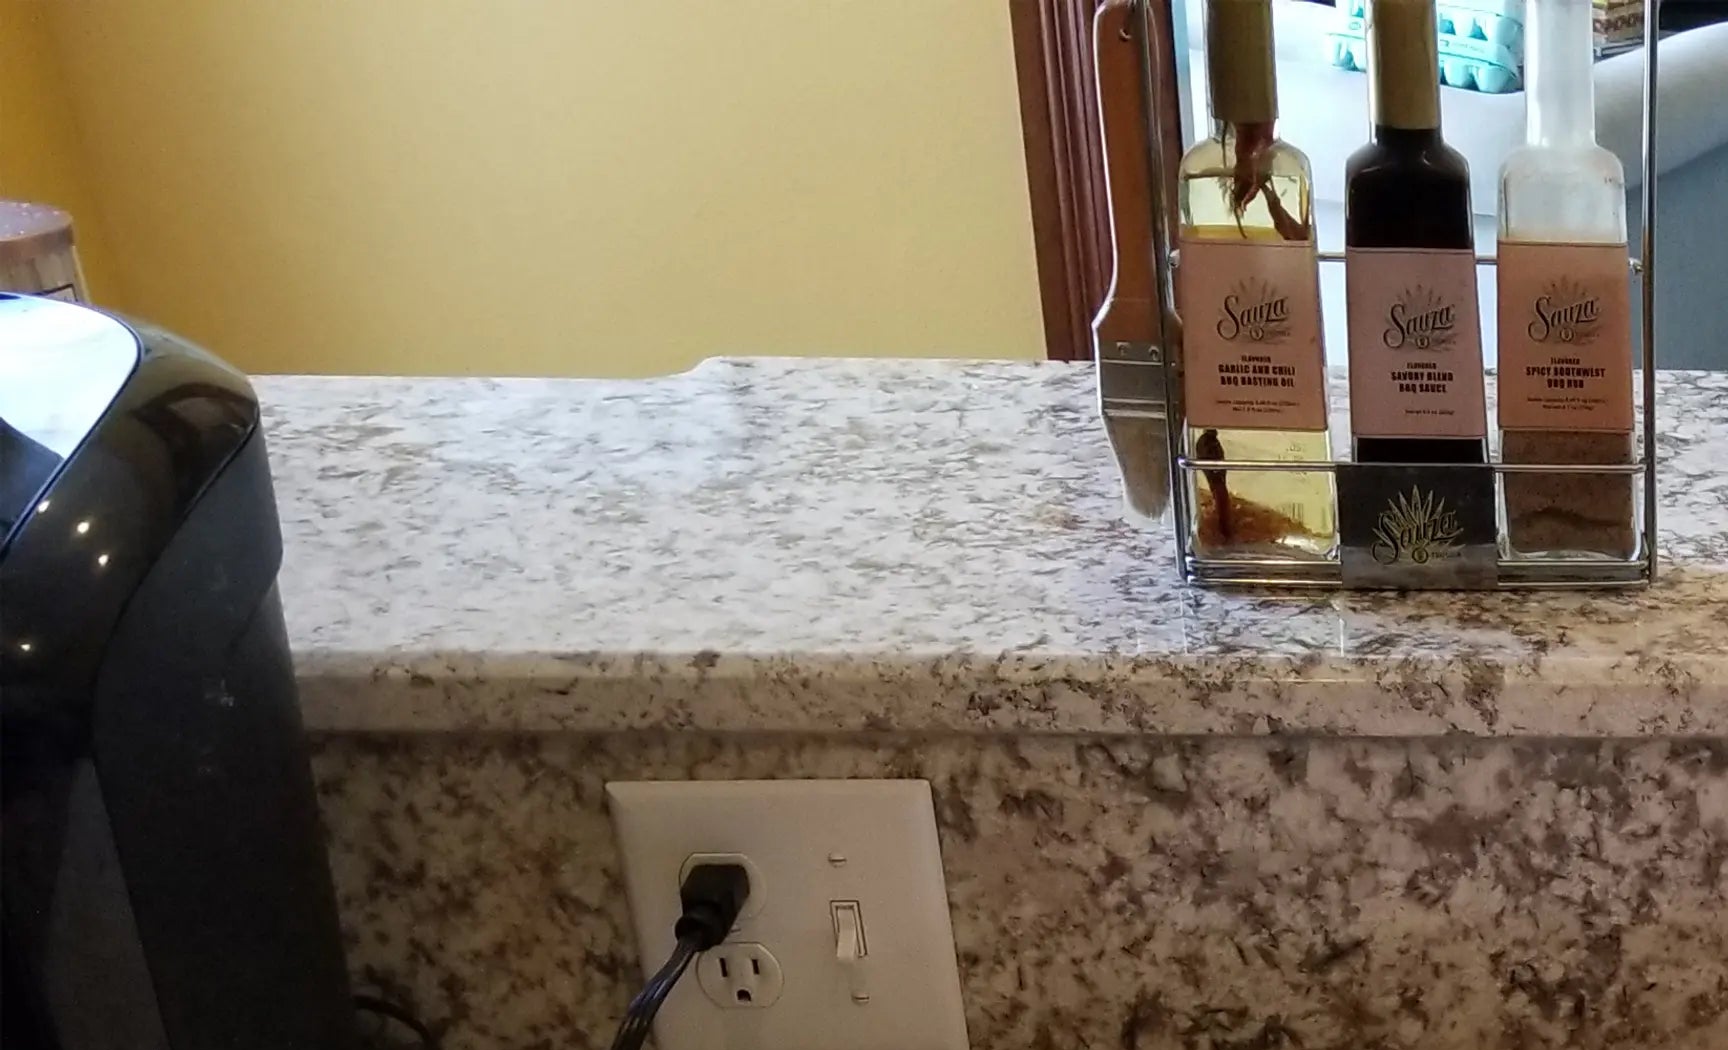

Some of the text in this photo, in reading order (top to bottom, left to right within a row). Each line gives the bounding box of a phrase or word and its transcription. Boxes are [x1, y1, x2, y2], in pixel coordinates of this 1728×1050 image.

[1217, 294, 1289, 340] Sauza
[1528, 296, 1599, 342] Sauza
[1383, 303, 1455, 349] Sauza
[1218, 364, 1296, 376] GARLIC AND CHILI
[1391, 371, 1453, 381] SAVORY BLEND
[1526, 366, 1606, 377] SPICY SOUTHWEST
[1221, 376, 1295, 388] BBQ BASTING OIL
[1399, 383, 1447, 393] BBQ SAUCE
[1547, 378, 1584, 389] BBQ RUB
[1371, 510, 1458, 565] Sauza
